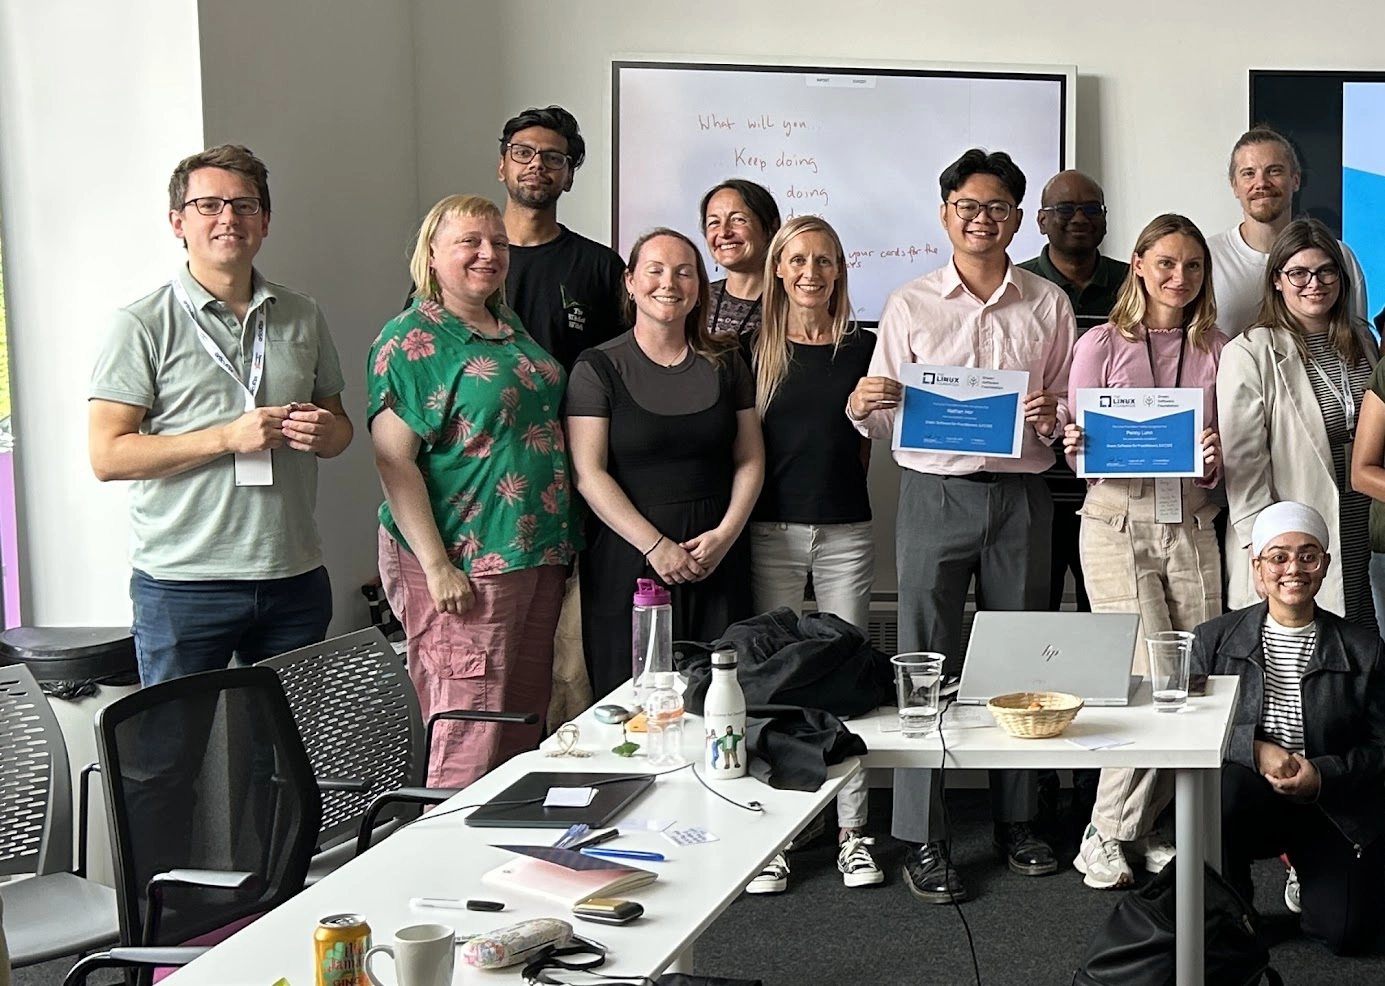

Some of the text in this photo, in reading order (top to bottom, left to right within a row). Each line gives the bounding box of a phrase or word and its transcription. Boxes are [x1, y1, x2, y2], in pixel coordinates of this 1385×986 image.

[698, 114, 735, 130] What
[747, 115, 774, 130] will
[734, 147, 818, 173] Keep doing
[786, 184, 829, 207] doing
[848, 250, 875, 262] your
[936, 375, 960, 384] LINUX
